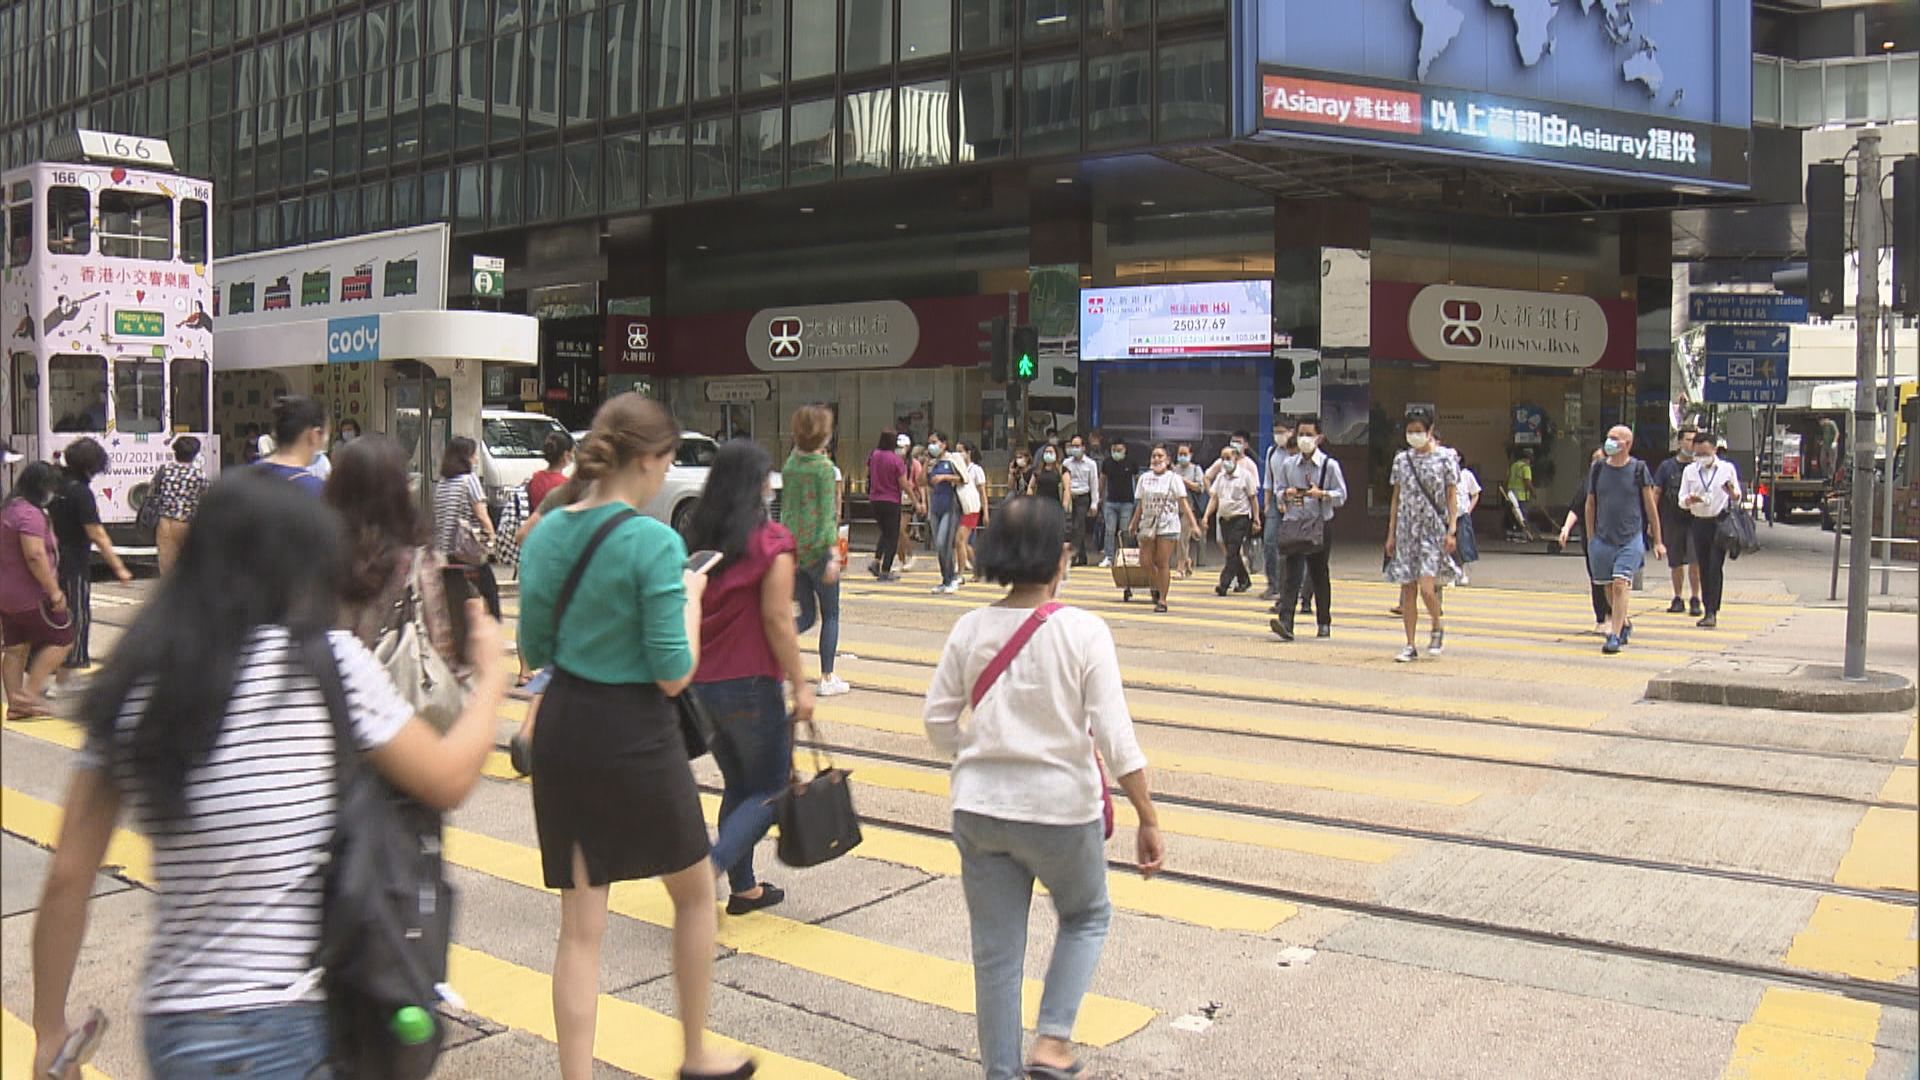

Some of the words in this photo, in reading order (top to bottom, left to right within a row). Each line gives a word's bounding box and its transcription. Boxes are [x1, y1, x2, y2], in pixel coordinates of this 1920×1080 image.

[1272, 88, 1351, 123] Asiaray
[1353, 96, 1412, 124] 雅仕維
[102, 136, 151, 159] 166
[52, 172, 76, 184] 166
[194, 187, 209, 199] 166
[81, 266, 190, 289] 香港小交響樂團
[1212, 301, 1231, 314] HSI
[1775, 297, 1803, 305] Station
[806, 314, 889, 338] 大新銀行
[1173, 318, 1226, 332] 25037.69
[1492, 303, 1582, 331] 大新銀行
[328, 324, 378, 354] cody
[1728, 378, 1762, 386] Kowloon
